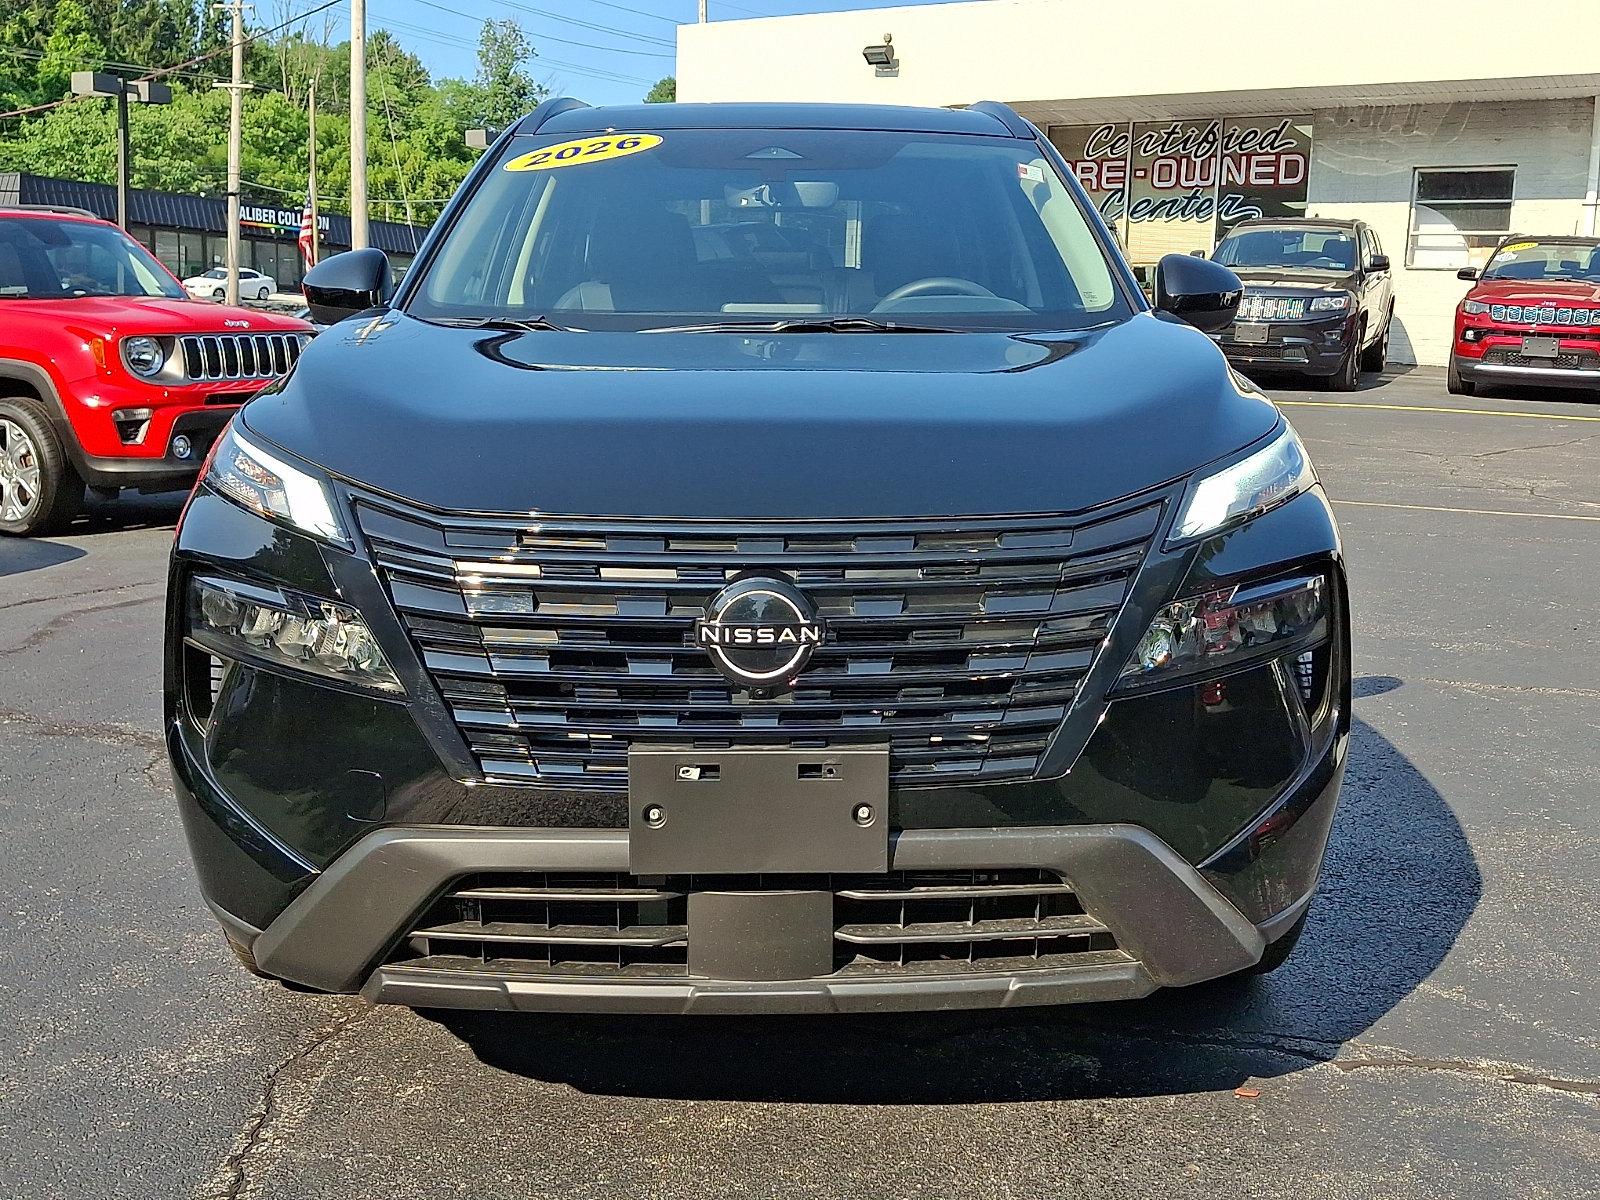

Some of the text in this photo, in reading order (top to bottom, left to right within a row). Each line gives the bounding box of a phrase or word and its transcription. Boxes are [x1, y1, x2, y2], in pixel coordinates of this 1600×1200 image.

[524, 137, 642, 168] 2026
[1084, 118, 1298, 160] Certified
[1066, 153, 1305, 191] RE-OWNED
[239, 205, 330, 230] ALIBER COLLON
[1098, 187, 1263, 222] Center
[701, 625, 819, 643] NISSAN
